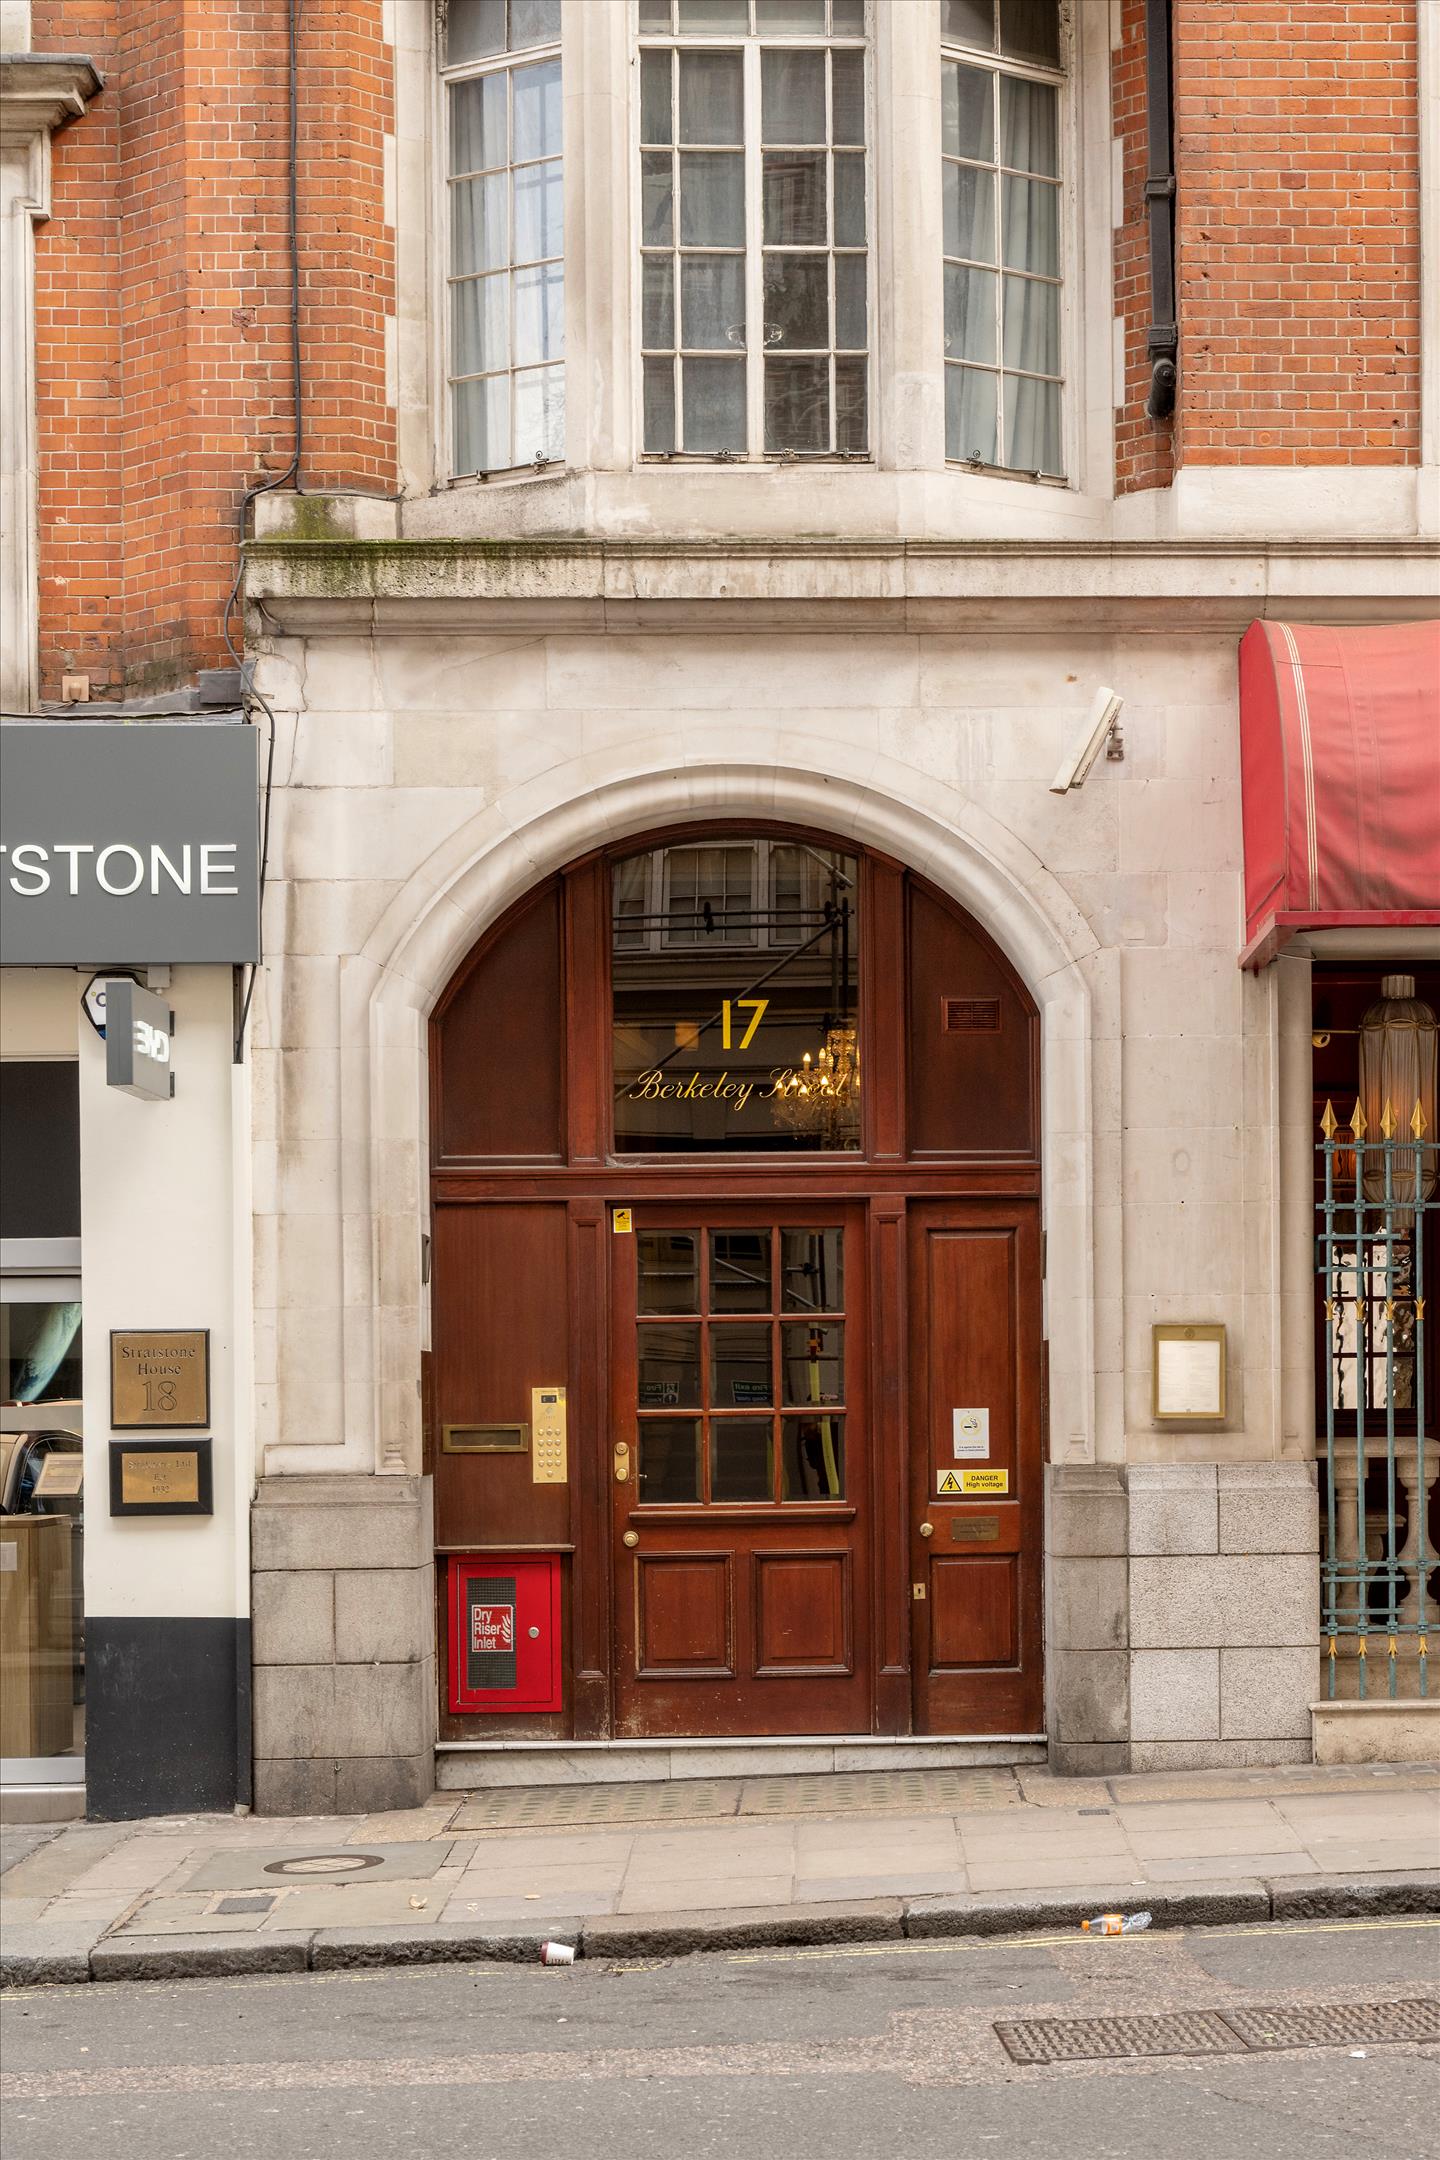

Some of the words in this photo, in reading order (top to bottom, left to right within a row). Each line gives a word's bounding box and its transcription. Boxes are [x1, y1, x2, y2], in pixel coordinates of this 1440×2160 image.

[0, 844, 238, 896] STONE
[722, 999, 769, 1049] 17
[629, 1069, 753, 1110] Berkeley
[759, 1068, 848, 1098] Street
[122, 1346, 196, 1359] Stratstone
[137, 1362, 182, 1375] House
[142, 1380, 177, 1411] 18
[474, 1608, 492, 1624] Dry
[474, 1622, 501, 1635] Riser
[474, 1636, 496, 1649] Inlet
